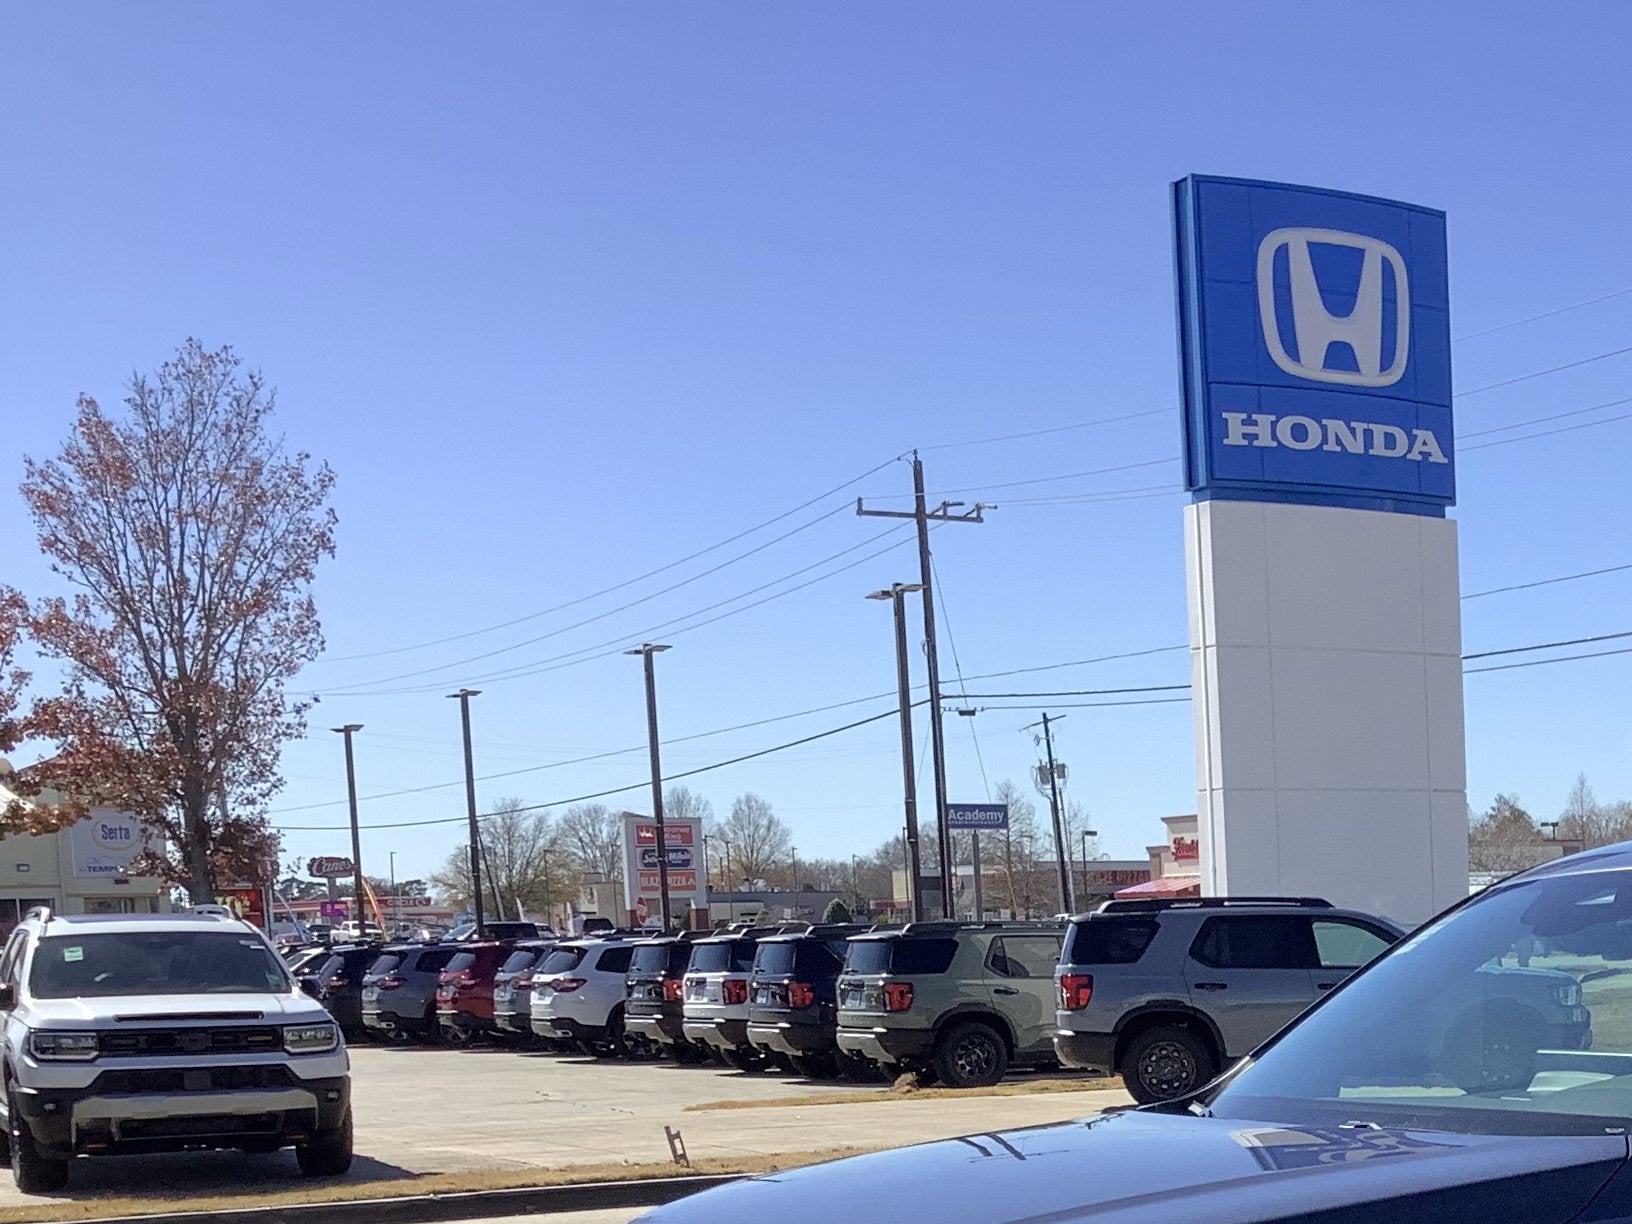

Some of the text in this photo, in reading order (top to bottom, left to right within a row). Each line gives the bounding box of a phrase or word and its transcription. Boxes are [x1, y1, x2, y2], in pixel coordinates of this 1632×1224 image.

[1222, 411, 1449, 464] HONDA
[947, 808, 1005, 823] Academy
[101, 823, 131, 840] Serta
